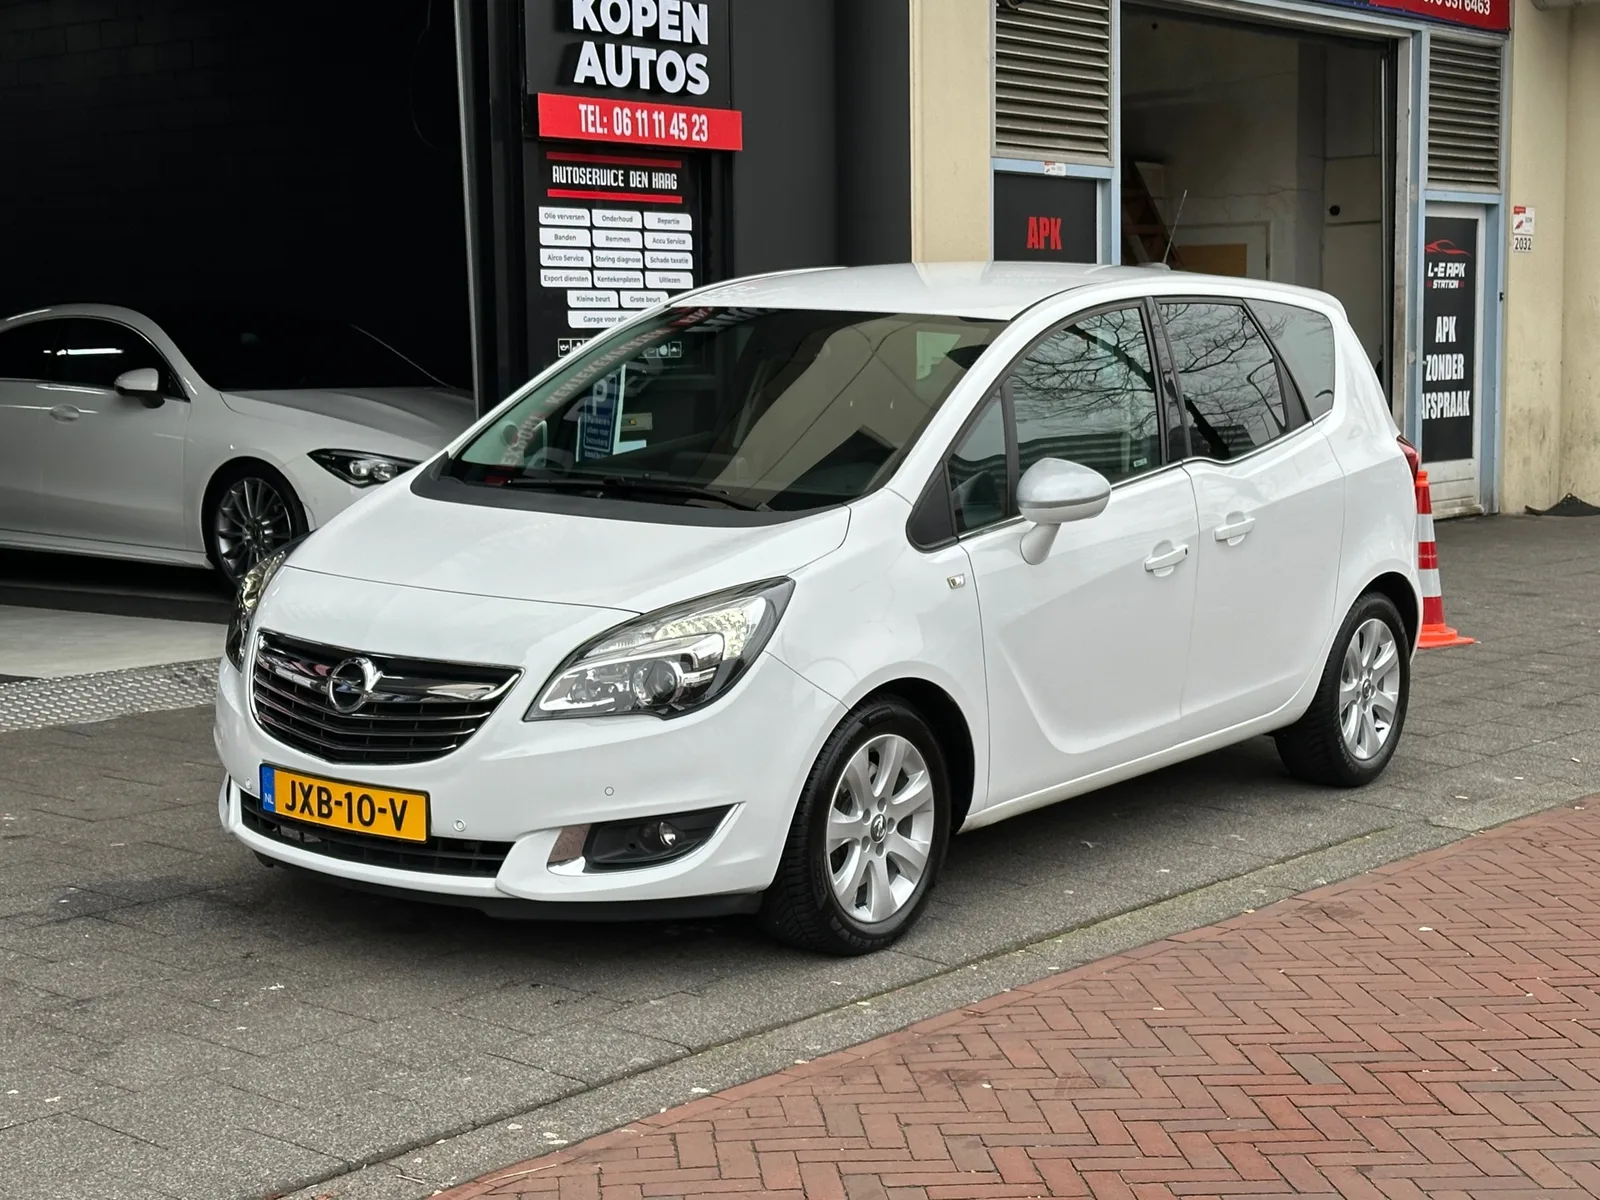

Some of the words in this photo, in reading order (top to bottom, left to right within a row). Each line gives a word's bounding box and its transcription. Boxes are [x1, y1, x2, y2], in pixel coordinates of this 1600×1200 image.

[572, 0, 709, 45] KOPEN
[573, 40, 710, 95] AUTOS
[578, 104, 607, 133] TEL:
[612, 106, 631, 136] 06
[635, 109, 649, 138] 11
[652, 110, 666, 139] 11
[669, 112, 688, 141] 45
[691, 113, 708, 142] 23
[552, 165, 624, 187] AUTOSERVICE
[629, 171, 649, 188] DEN
[652, 172, 678, 190] HAAG
[544, 212, 556, 220] Olie
[601, 215, 633, 223] Onderhoud
[554, 233, 577, 241] Banden
[1027, 216, 1062, 250] APK
[605, 235, 631, 243] Remmen
[1514, 237, 1532, 251] 2032
[547, 254, 562, 262] Airco
[563, 254, 584, 262] Service
[595, 255, 616, 264] Storing
[616, 256, 641, 265] diagnose
[670, 257, 689, 265] taxatie
[1446, 262, 1466, 278] APK
[543, 275, 563, 283] Export
[563, 274, 589, 282] diensten
[597, 276, 641, 284] Kentekenplaten
[1432, 279, 1460, 289] STATION
[576, 295, 594, 303] Kleine
[595, 295, 611, 303] beurt
[583, 315, 603, 324] Garage
[1435, 316, 1457, 343] APK
[1425, 353, 1465, 382] ZONDER
[264, 792, 275, 805] NL
[284, 780, 408, 832] JXB-10-V
